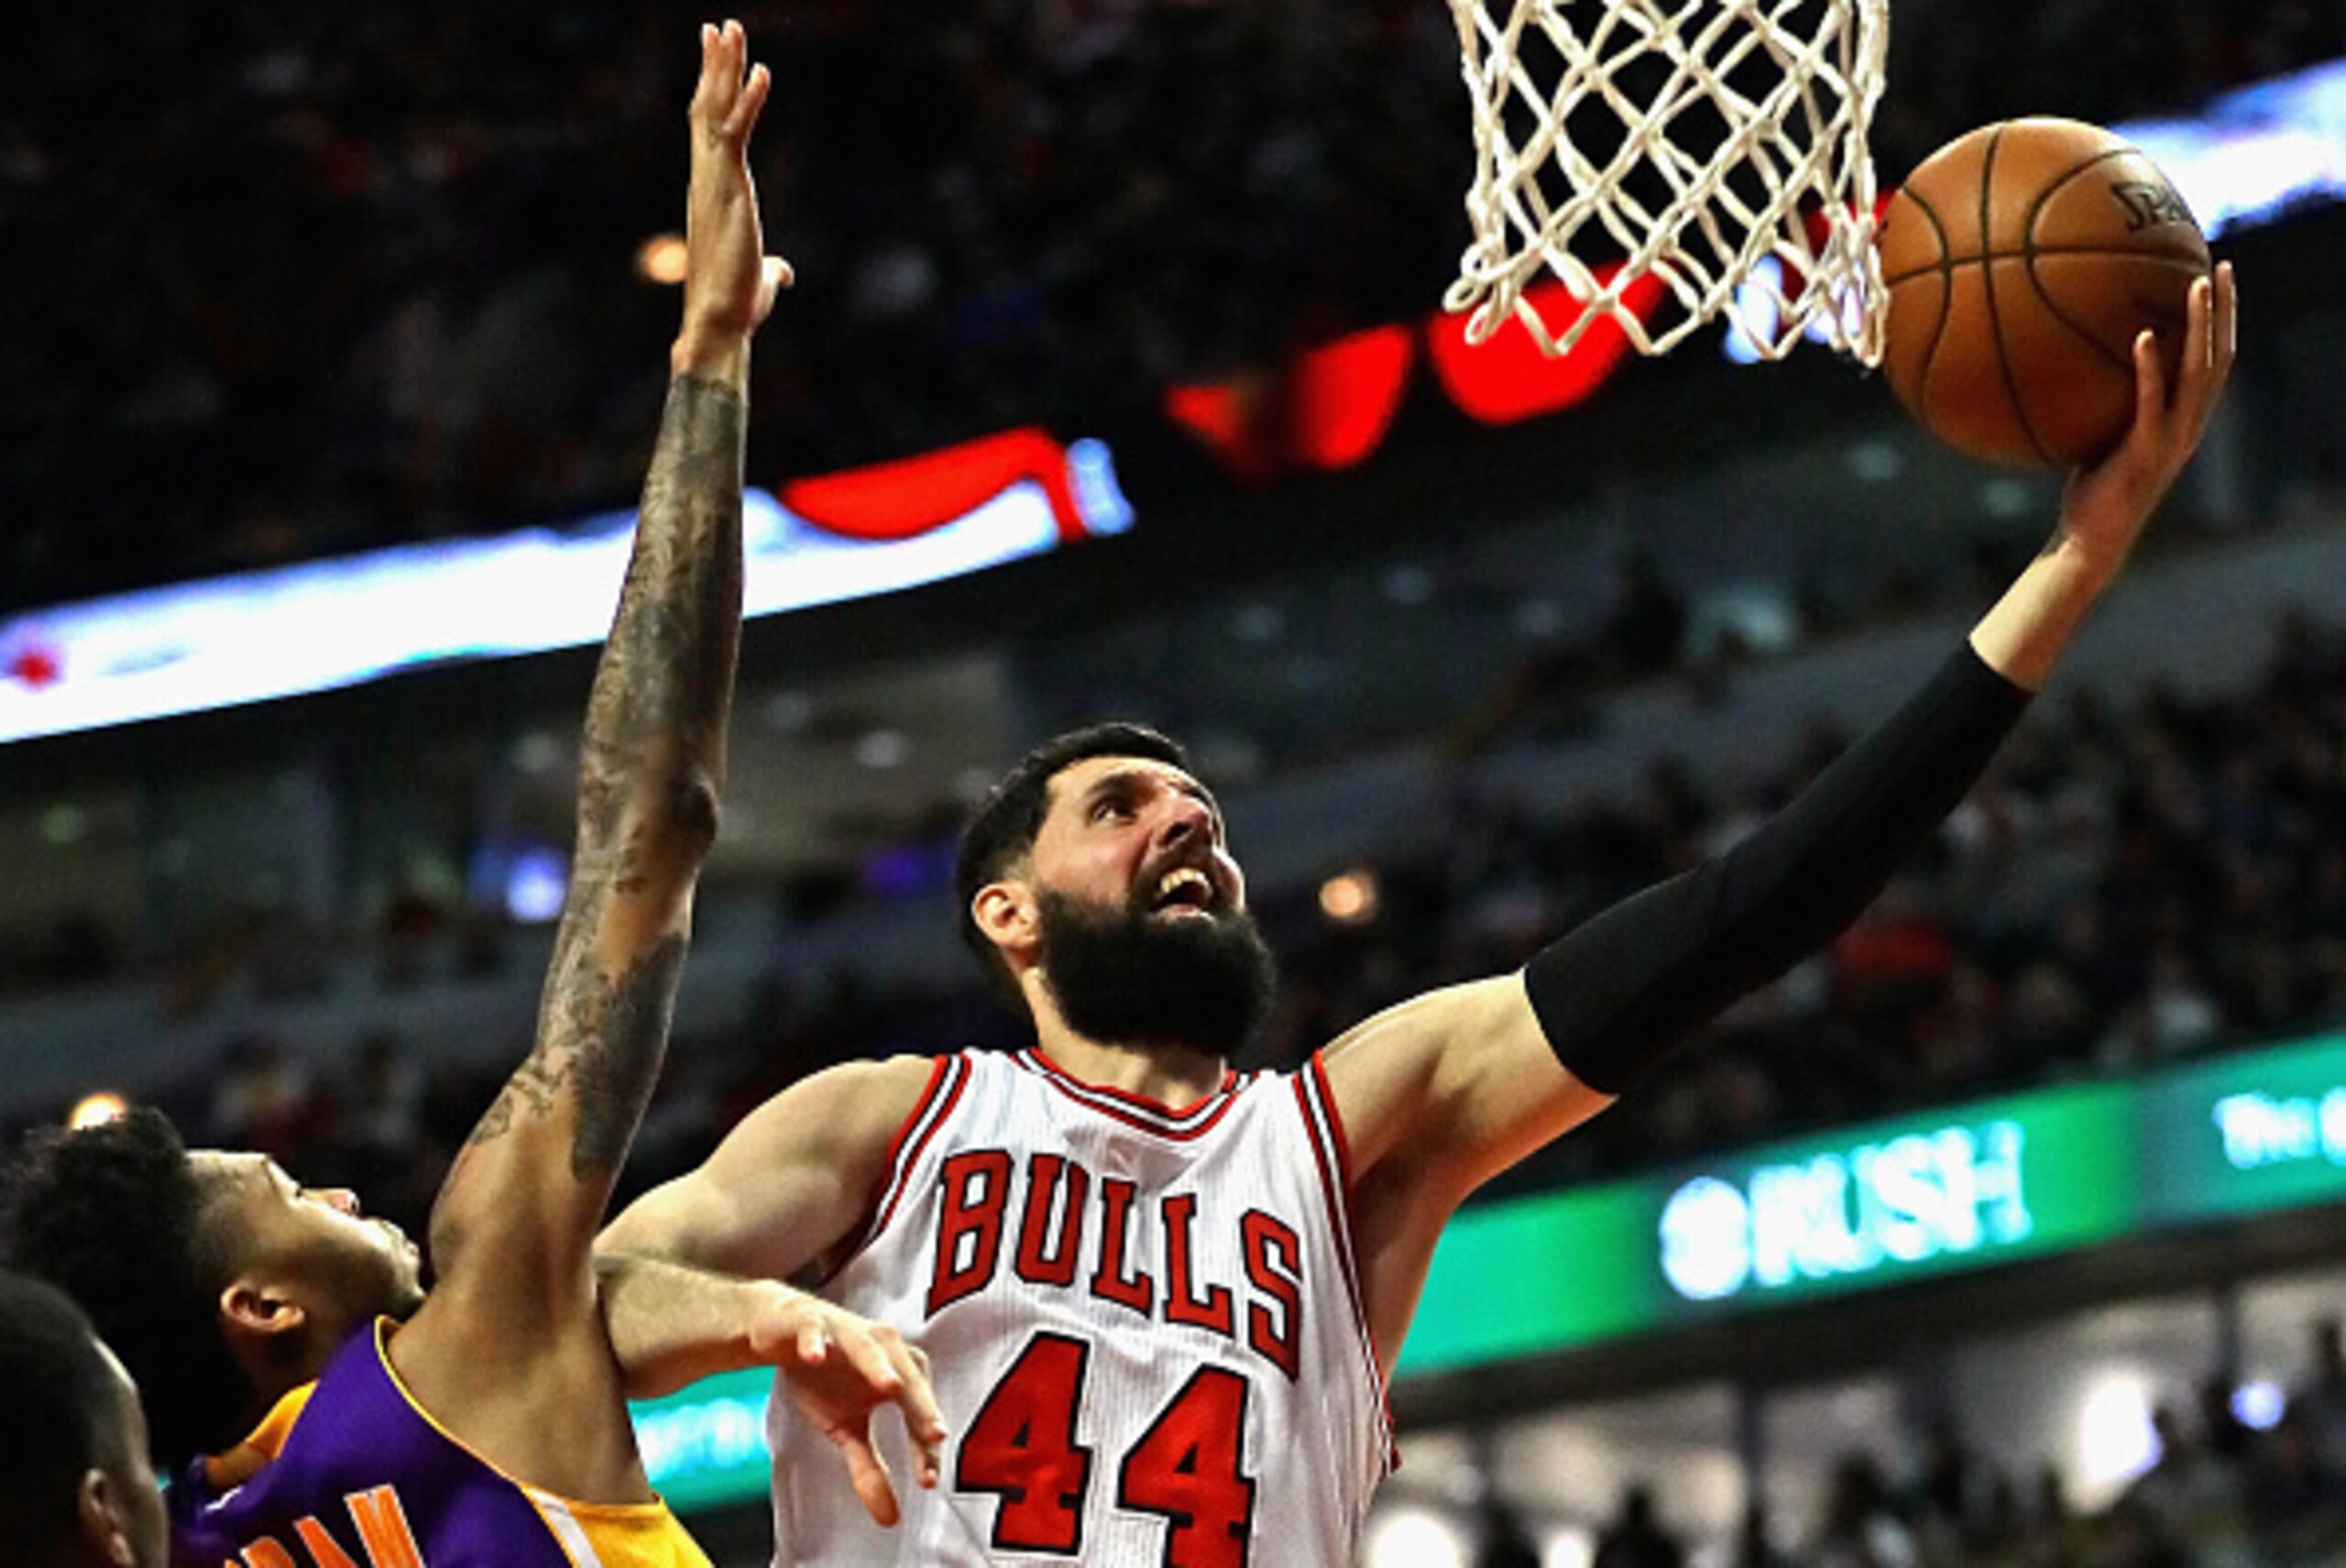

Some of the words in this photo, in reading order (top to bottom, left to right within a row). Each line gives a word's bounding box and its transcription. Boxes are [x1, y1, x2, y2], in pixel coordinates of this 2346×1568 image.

[926, 1147, 1303, 1385] BULLS
[1751, 1120, 2032, 1287] RUSH
[956, 1331, 1256, 1568] 44
